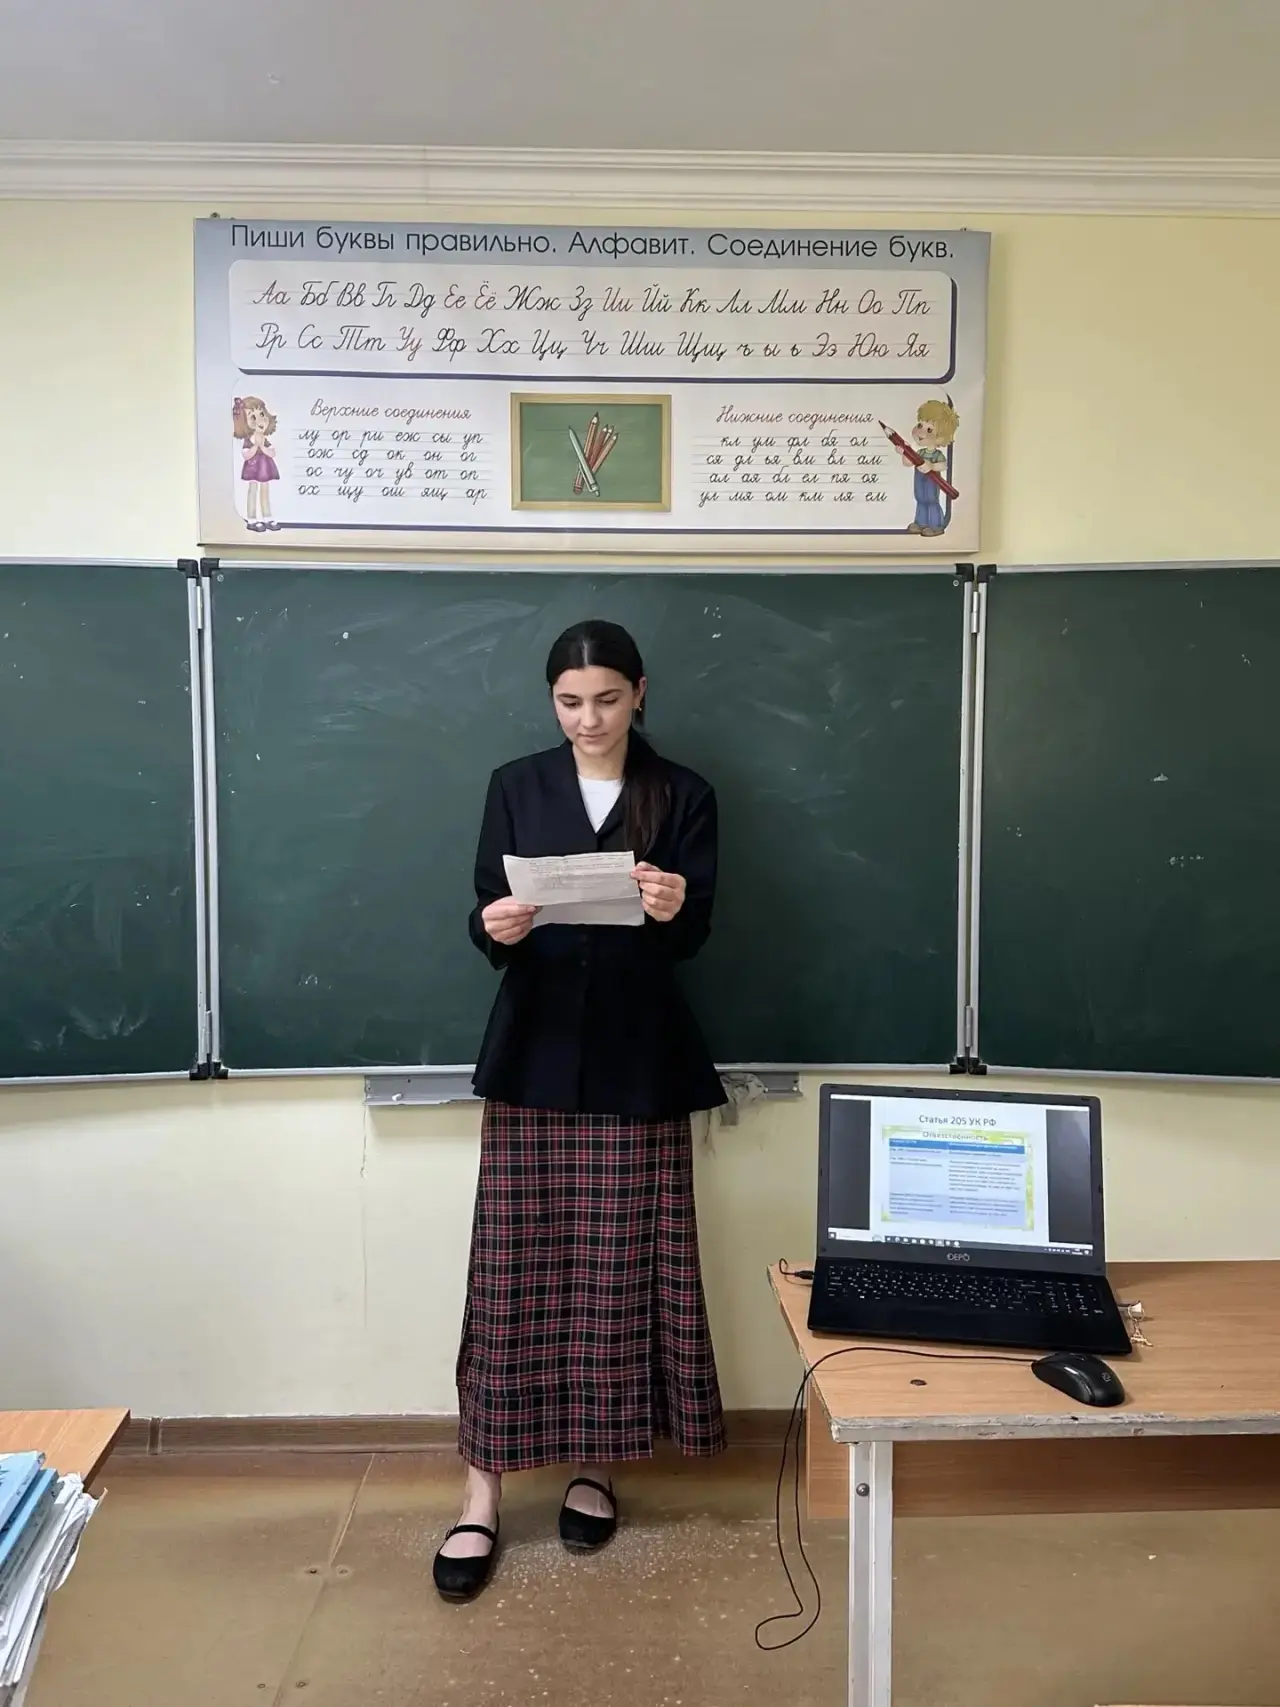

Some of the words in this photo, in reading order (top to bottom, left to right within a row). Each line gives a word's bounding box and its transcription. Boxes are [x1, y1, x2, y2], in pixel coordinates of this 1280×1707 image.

[231, 224, 305, 248] Пиши
[316, 226, 394, 255] буквы
[406, 232, 556, 256] правильно.
[568, 231, 695, 259] Алфавит.
[707, 233, 878, 259] Соединение
[889, 235, 954, 262] букв.
[252, 279, 291, 305] Аа
[300, 280, 339, 307] Бб
[336, 281, 366, 308] Вв
[371, 281, 397, 309] Гг
[403, 282, 436, 318] Дд
[444, 283, 466, 309] Ее
[474, 280, 497, 310] Ёё
[503, 284, 561, 312] Жж
[568, 285, 593, 321] Зз
[602, 286, 634, 313] Ии
[642, 283, 672, 314] Йй
[679, 287, 711, 314] Кк
[716, 288, 753, 314] Лл
[757, 288, 807, 314] Мм
[815, 288, 849, 314] Нн
[858, 288, 883, 314] Оо
[891, 288, 930, 316] Пп
[255, 322, 287, 360] Рр
[297, 323, 322, 350] Сс
[332, 324, 386, 351] Тт
[395, 325, 422, 362] Уу
[432, 327, 467, 362] Фф
[476, 327, 520, 354] Хх
[532, 329, 568, 361] Цц
[581, 329, 609, 355] Чч
[620, 330, 666, 356] Шш
[677, 331, 728, 362] Щщ
[736, 342, 754, 357] ъ
[762, 342, 781, 357] ы
[789, 343, 802, 357] ь
[811, 332, 838, 358] Ээ
[847, 332, 890, 358] Юю
[897, 332, 930, 358] Яя
[310, 398, 380, 424] Верхние
[384, 408, 472, 425] соединения
[716, 405, 783, 423] Нижние
[788, 412, 874, 430] соединения
[299, 430, 321, 447] лу
[331, 430, 351, 448] ор
[359, 431, 384, 448] ри
[395, 432, 421, 442] еж
[432, 433, 452, 443] сы
[462, 433, 483, 450] уп
[720, 436, 742, 447] кл
[751, 436, 776, 453] ум
[787, 436, 810, 453] фл
[821, 429, 839, 447] бя
[850, 437, 869, 447] ол
[307, 448, 335, 459] ож
[352, 449, 370, 466] сд
[386, 449, 406, 460] ок
[423, 450, 443, 461] он
[460, 451, 477, 462] ог
[706, 454, 723, 465] ся
[733, 454, 754, 472] дл
[764, 455, 781, 465] ья
[792, 448, 816, 465] вм
[827, 448, 847, 465] вл
[857, 455, 883, 465] ам
[305, 466, 323, 477] ос
[334, 467, 354, 484] чу
[365, 467, 384, 478] оч
[394, 462, 414, 486] ув
[424, 468, 449, 480] от
[460, 469, 480, 480] оп
[709, 473, 731, 483] ал
[741, 473, 762, 483] ая
[772, 465, 791, 484] бл
[801, 473, 820, 483] ел
[831, 473, 851, 483] пя
[862, 473, 880, 483] оя
[298, 485, 321, 495] ох
[337, 485, 365, 503] щу
[381, 486, 405, 497] ош
[420, 487, 448, 501] ящ
[465, 488, 488, 505] ар
[698, 491, 720, 508] ул
[729, 491, 754, 502] мя
[765, 492, 789, 502] ом
[798, 492, 824, 502] км
[833, 492, 854, 502] ля
[865, 492, 888, 502] ем
[919, 1115, 948, 1124] Статья
[950, 1116, 967, 1125] 205
[968, 1117, 982, 1126] УК
[983, 1118, 997, 1127] РФ
